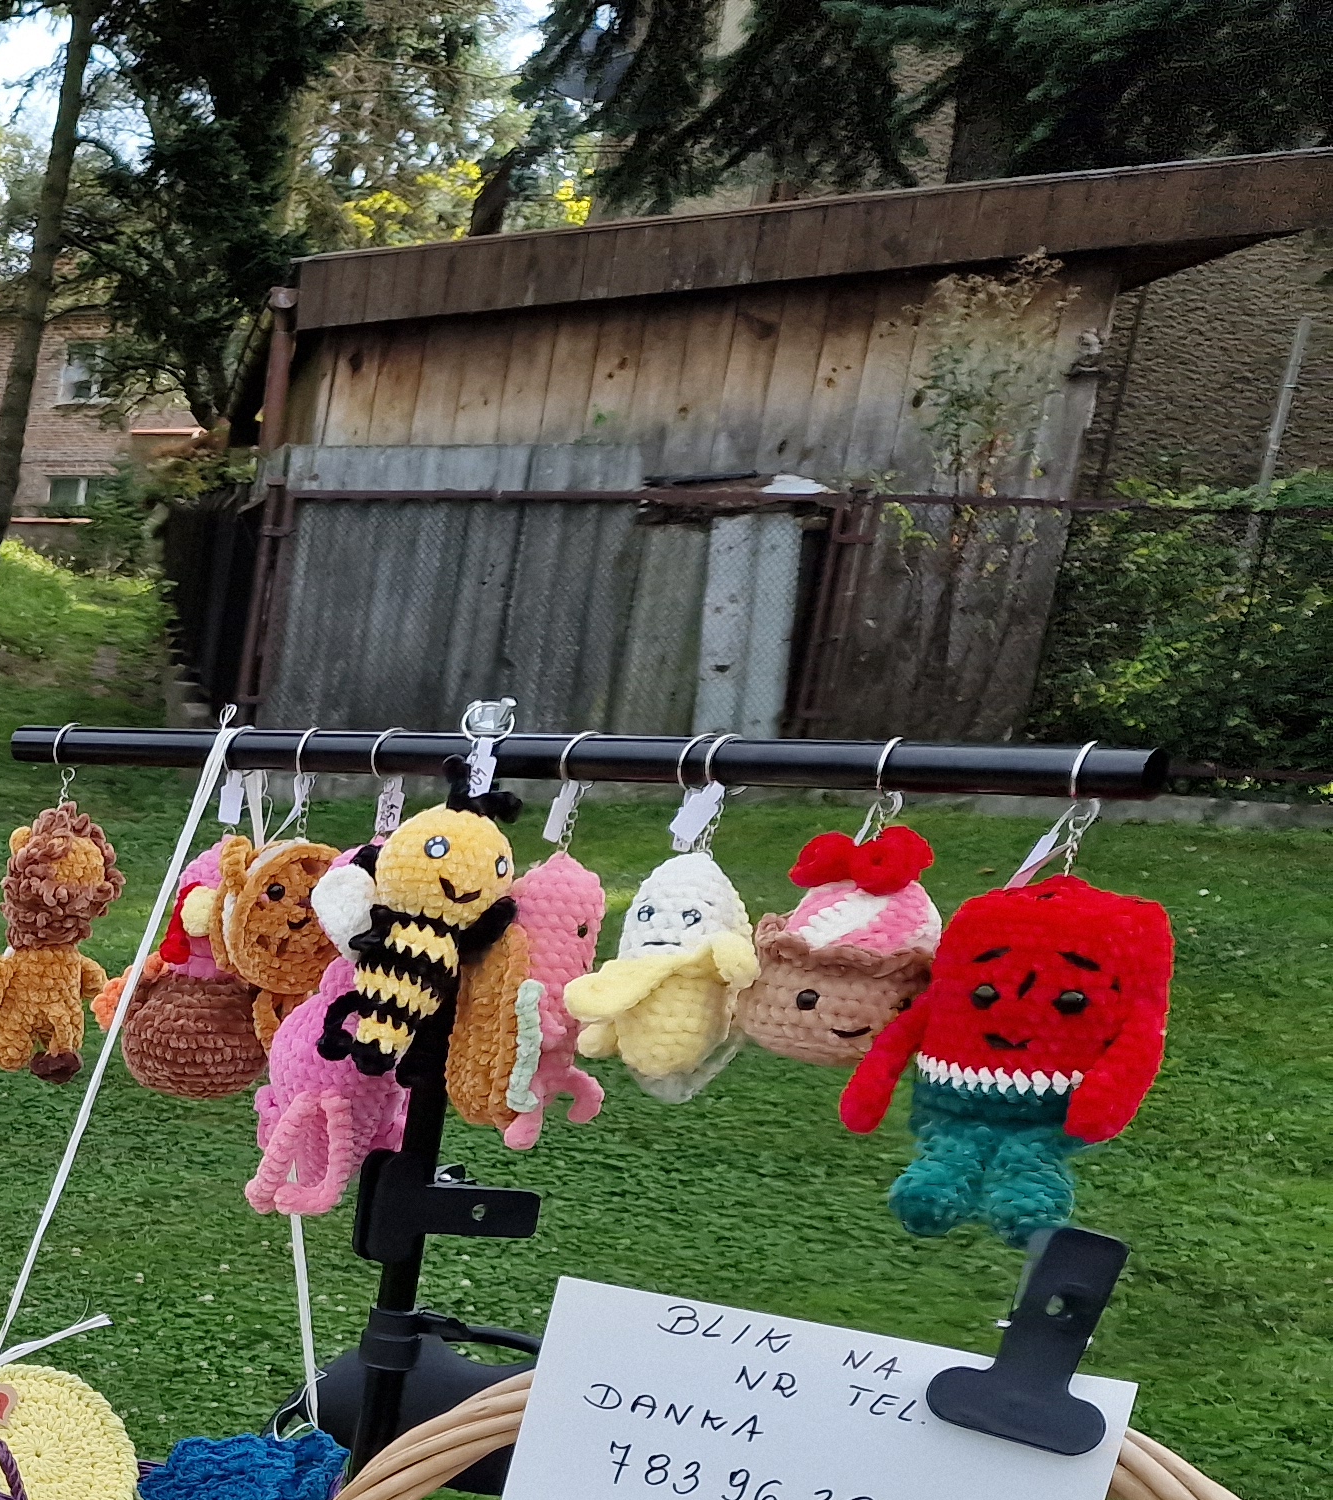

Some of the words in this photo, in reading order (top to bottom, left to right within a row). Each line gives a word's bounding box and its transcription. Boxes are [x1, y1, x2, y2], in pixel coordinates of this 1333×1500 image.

[656, 1304, 793, 1354] BLIK
[841, 1349, 903, 1381] NA
[582, 1383, 765, 1443] DANKA
[734, 1365, 799, 1399] NR
[848, 1384, 927, 1425] TEL.
